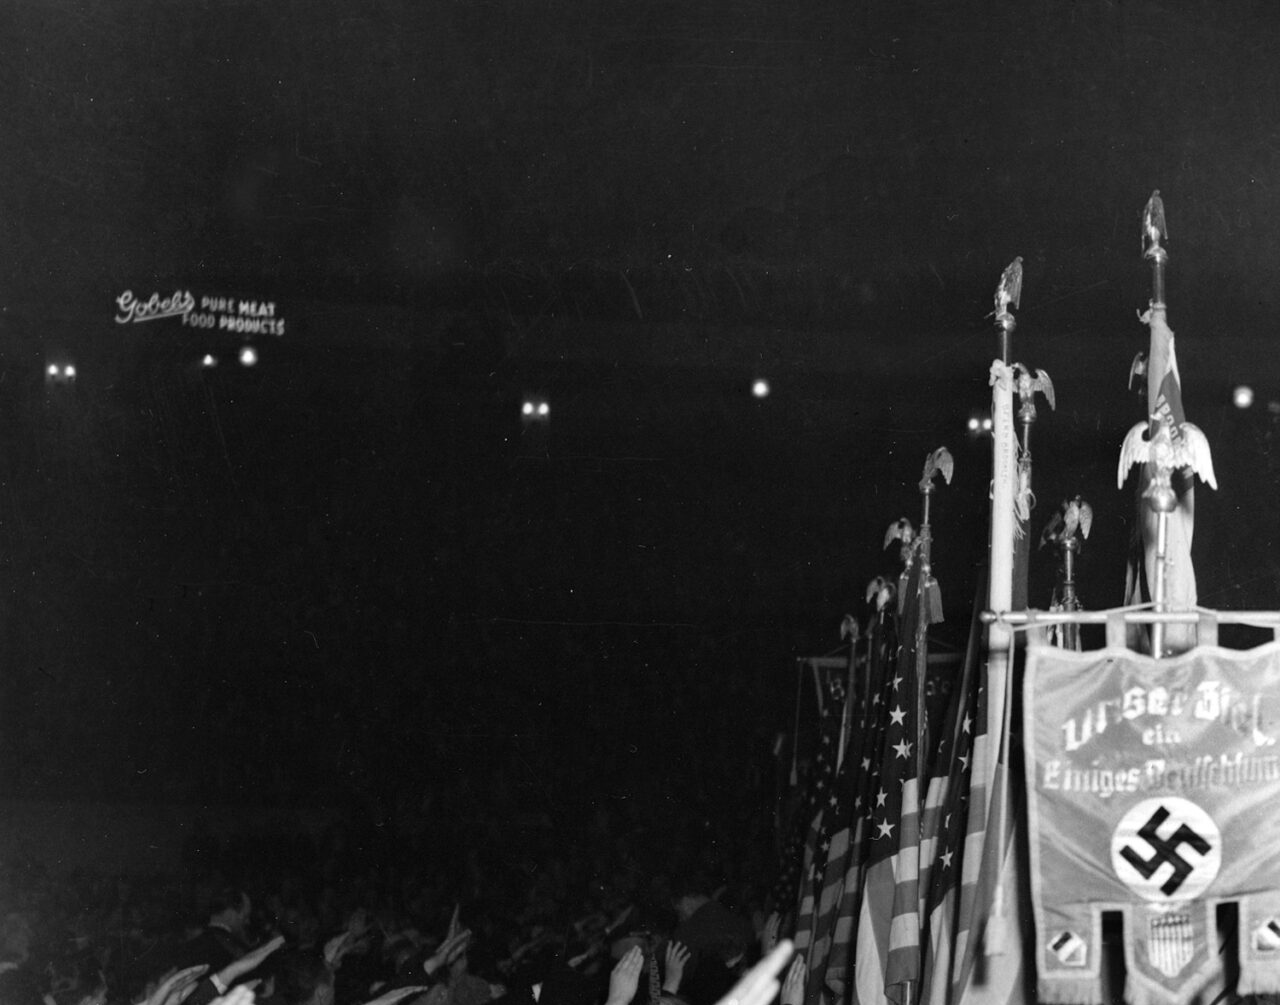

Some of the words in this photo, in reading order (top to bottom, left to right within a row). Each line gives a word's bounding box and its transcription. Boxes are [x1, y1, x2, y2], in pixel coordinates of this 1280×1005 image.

[201, 295, 235, 313] PURE
[238, 300, 276, 317] MEAT
[182, 312, 215, 328] FOOD
[219, 316, 285, 336] PRODUCTS
